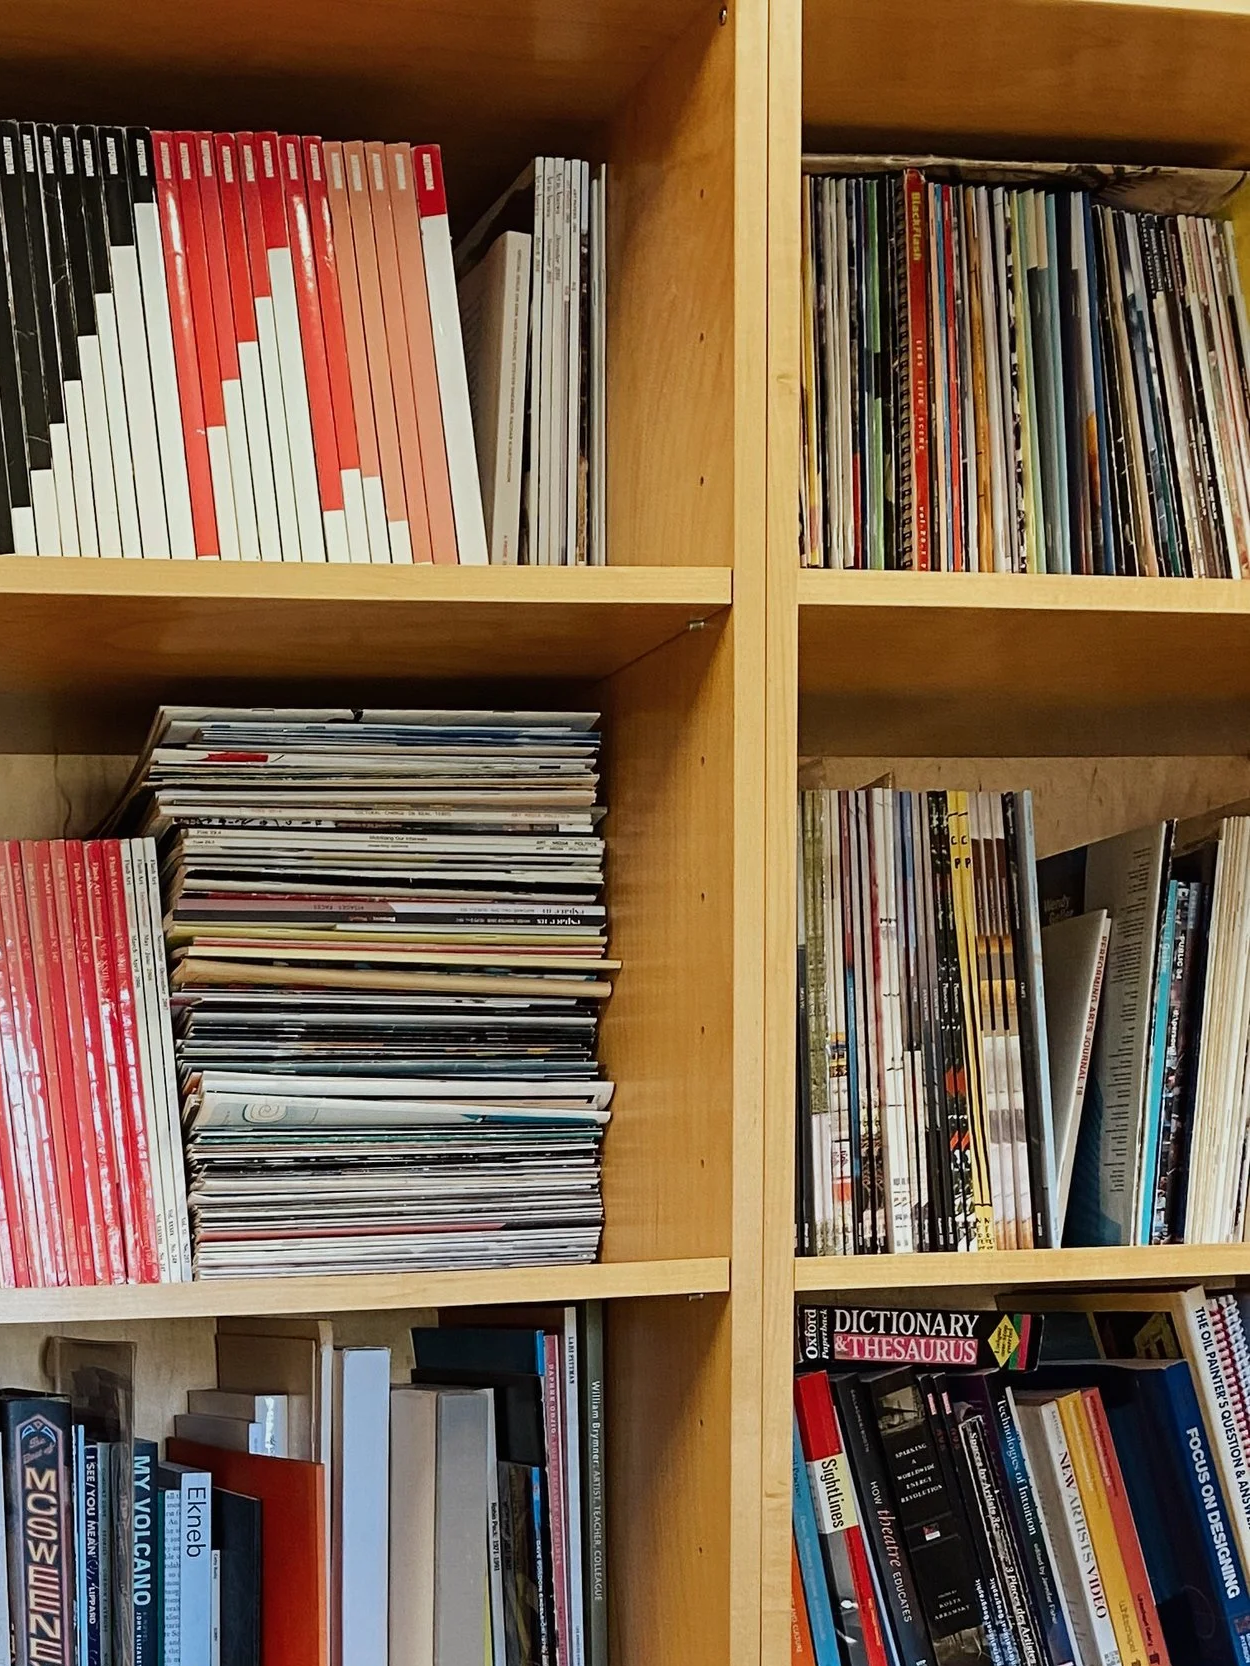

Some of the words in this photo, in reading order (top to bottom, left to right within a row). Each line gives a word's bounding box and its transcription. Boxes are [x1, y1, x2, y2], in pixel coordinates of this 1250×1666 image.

[1090, 936, 1107, 1000] PERFORMING
[1086, 1007, 1099, 1034] ARTS
[1078, 1034, 1093, 1082] JOURNAL
[805, 1309, 817, 1359] Oxford
[820, 1309, 829, 1359] Paperback
[835, 1309, 979, 1337] DICTIONARY
[591, 1381, 600, 1419] William
[1195, 1306, 1206, 1329] THE
[1201, 1332, 1210, 1351] OIL
[1206, 1352, 1229, 1409] PAINTER'S
[1221, 1410, 1244, 1468] QUESTION
[1235, 1469, 1246, 1480] &
[998, 1397, 1020, 1461] Technologies
[134, 1455, 150, 1490] MY
[1016, 1464, 1026, 1480] of
[1186, 1427, 1210, 1483] FOCUS
[186, 1486, 207, 1558] Ekneb
[1018, 1484, 1036, 1535] Intuition
[1202, 1485, 1217, 1508] ON
[134, 1499, 152, 1606] VOLCANO
[870, 1481, 882, 1505] HOW
[877, 1510, 901, 1567] theatre
[893, 1573, 912, 1622] EDUCATES
[1059, 1452, 1077, 1489] NEW
[1069, 1495, 1093, 1564] ARTISTS
[1088, 1565, 1106, 1618] VIDEO
[1208, 1511, 1240, 1599] DESIGNING
